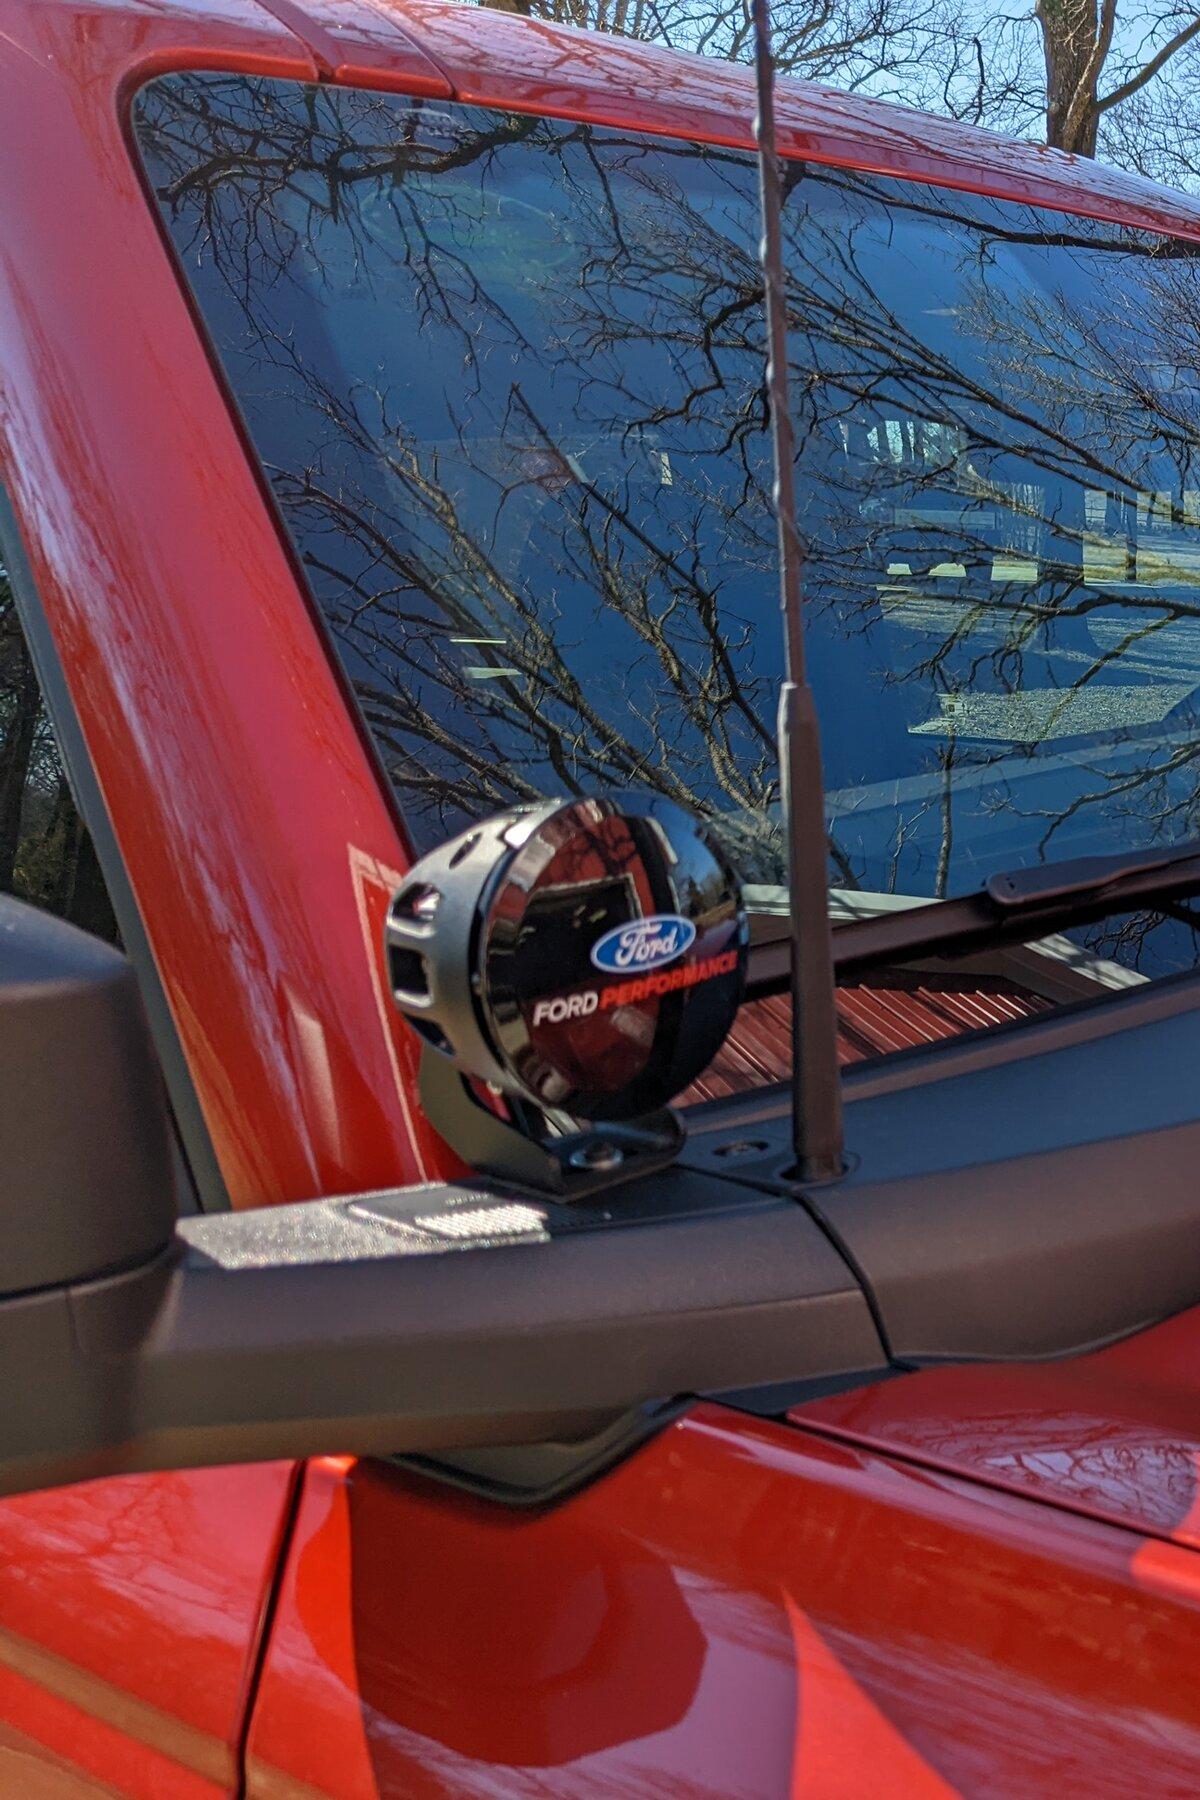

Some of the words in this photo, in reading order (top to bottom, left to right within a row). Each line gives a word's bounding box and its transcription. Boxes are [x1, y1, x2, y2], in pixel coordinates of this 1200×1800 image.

[614, 923, 678, 967] Ford
[533, 990, 599, 1027] FORD
[601, 951, 738, 1009] PERFORMANCE
